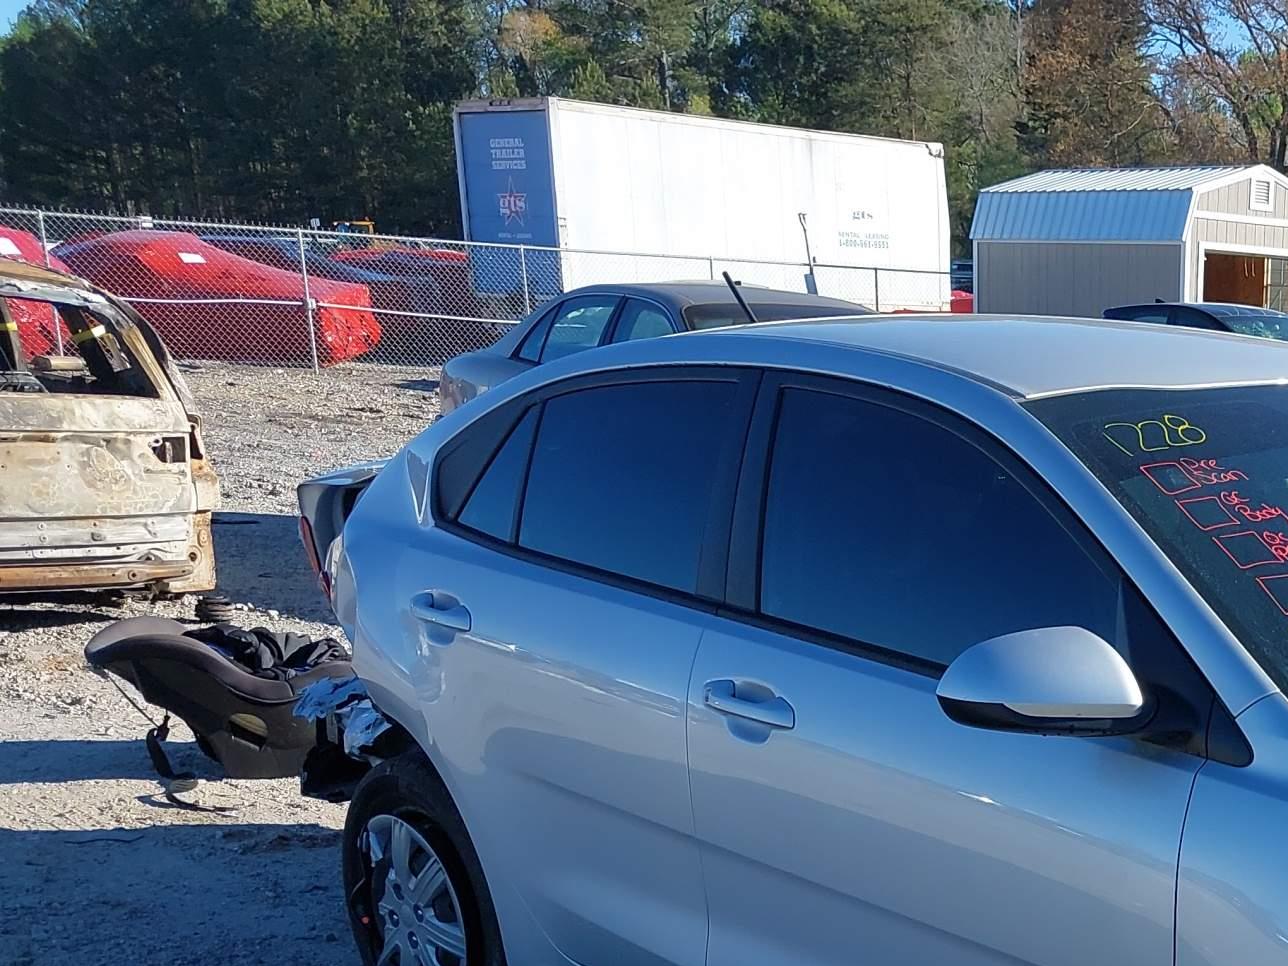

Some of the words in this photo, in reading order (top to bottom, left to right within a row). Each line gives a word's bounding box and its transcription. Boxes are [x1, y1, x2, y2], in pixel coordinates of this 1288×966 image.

[489, 138, 525, 148] GENERAL
[490, 148, 525, 159] TRAILER
[491, 160, 527, 170] SERVICES
[1180, 458, 1225, 474] Pre
[1193, 470, 1249, 485] Scan
